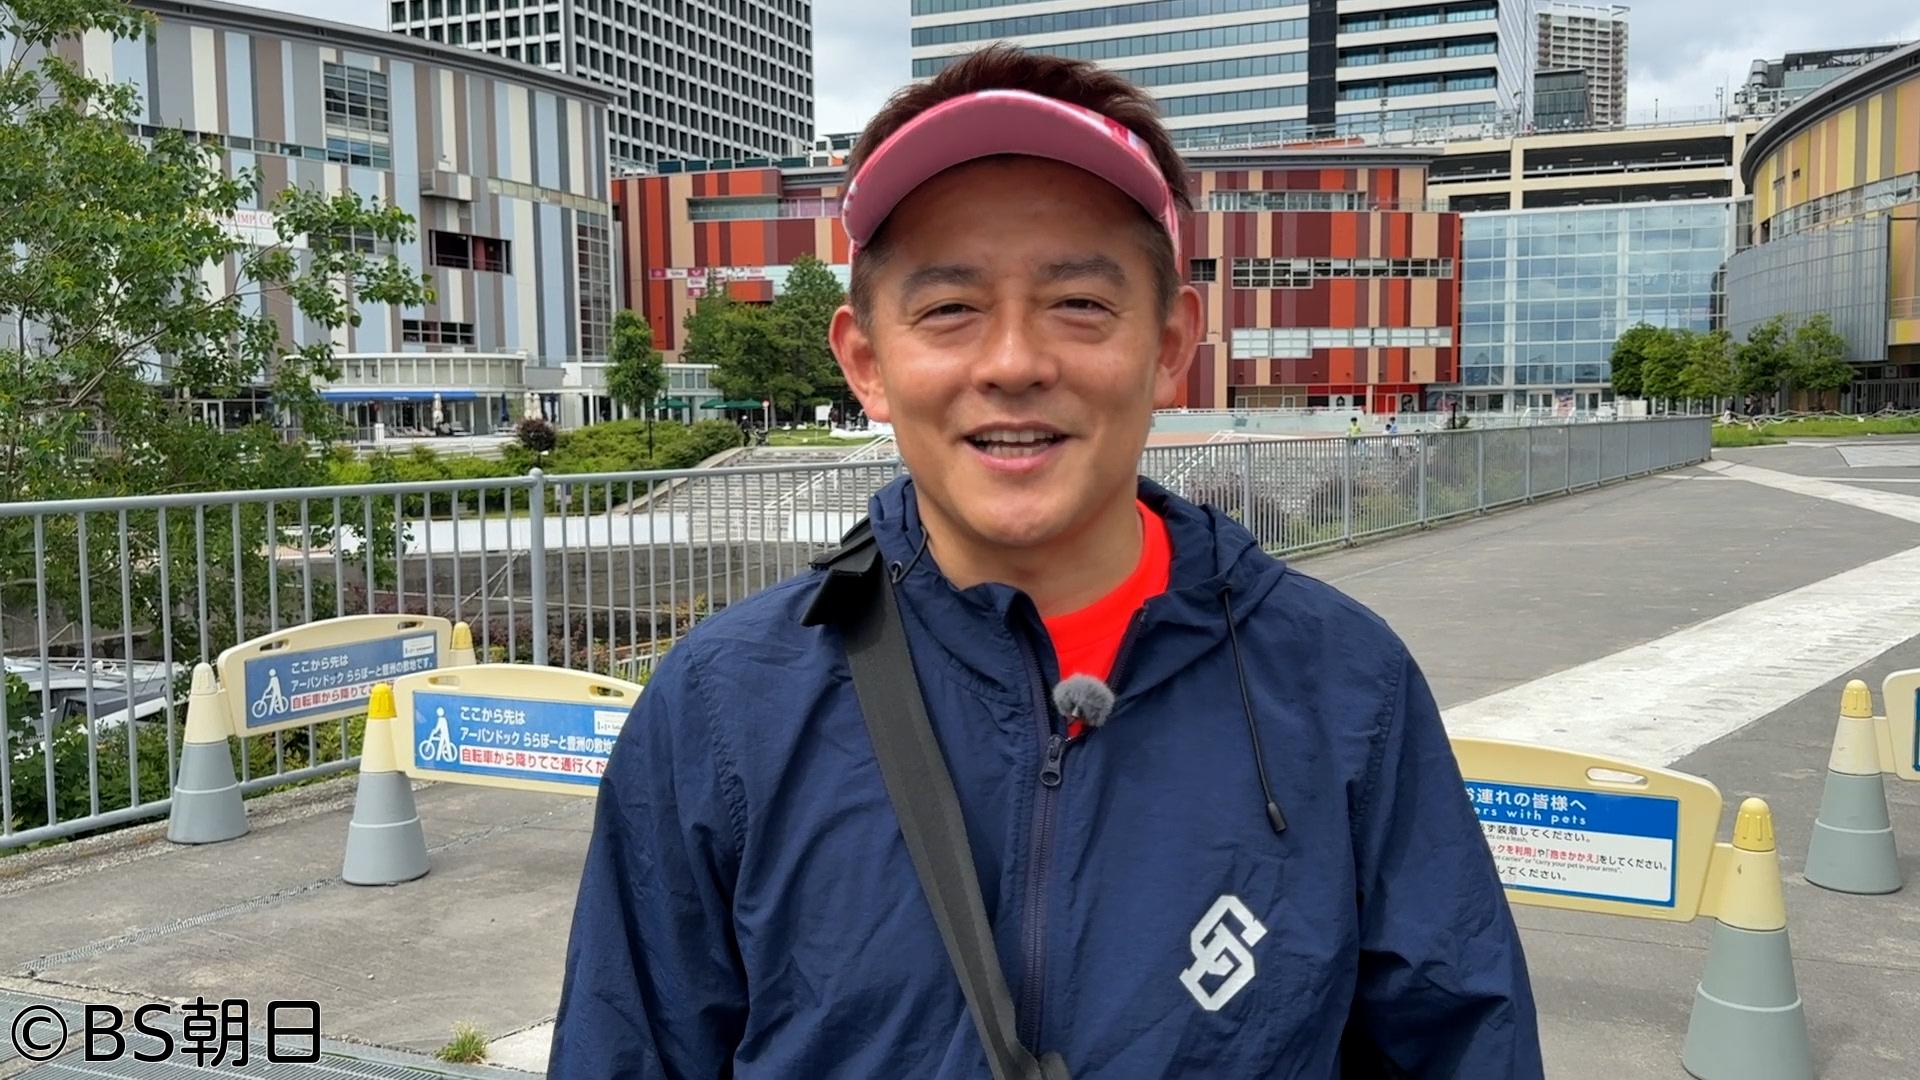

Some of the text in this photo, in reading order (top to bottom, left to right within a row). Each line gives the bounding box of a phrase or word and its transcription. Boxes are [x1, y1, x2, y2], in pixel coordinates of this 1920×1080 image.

[291, 654, 349, 674] ここから先は
[291, 672, 344, 692] アーバンドック
[460, 706, 526, 725] ここから先は
[460, 727, 520, 746] アーバンドック
[1506, 808, 1542, 821] with
[1551, 815, 1586, 826] pets
